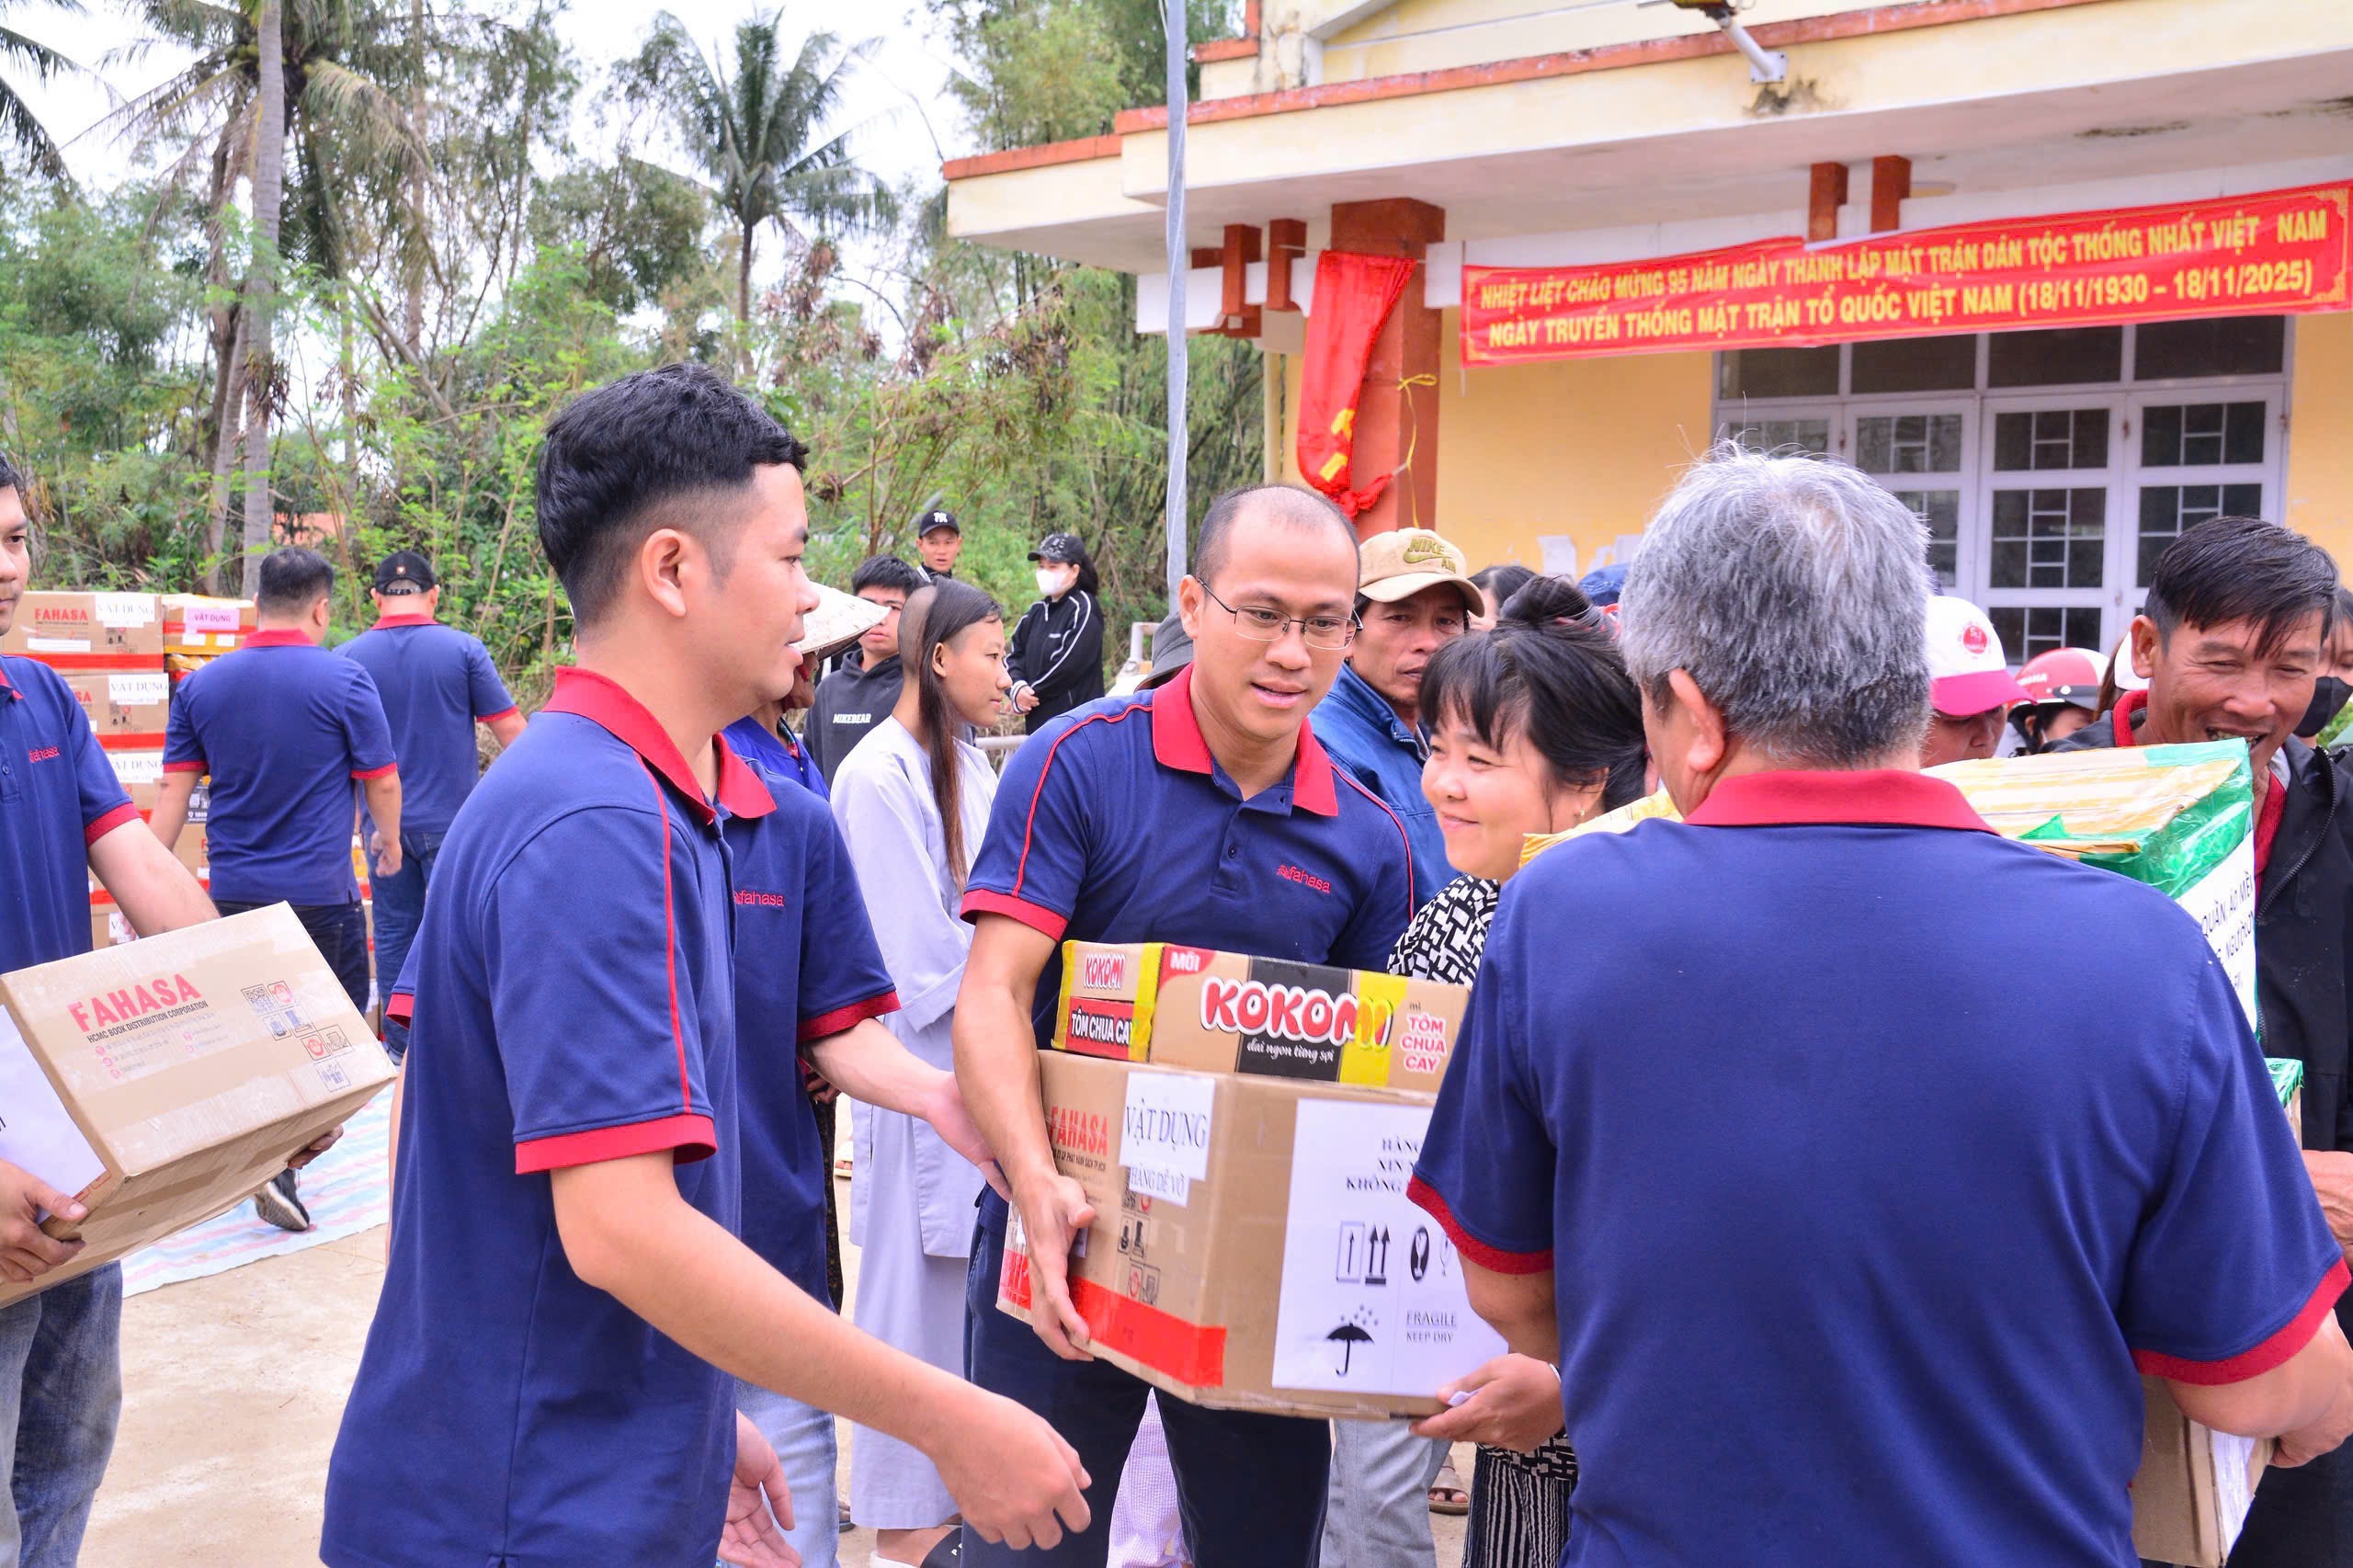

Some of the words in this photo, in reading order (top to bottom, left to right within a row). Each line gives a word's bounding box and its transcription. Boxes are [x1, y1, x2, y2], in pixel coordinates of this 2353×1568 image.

[1481, 278, 1528, 313] NHIỆT
[1529, 275, 1564, 312] LIỆT
[1566, 272, 1611, 302] CHÀO
[1614, 268, 1665, 299] MỪNG
[1668, 269, 1688, 294] 95
[1691, 261, 1729, 292] NĂM
[1733, 255, 1779, 289] NGÀY
[1785, 251, 1843, 285] THÀNH
[1847, 245, 1881, 286] LẬP
[1886, 244, 1924, 283] MẶT
[1929, 238, 1979, 279] TRẬN
[1983, 234, 2023, 269] DÂN
[2028, 230, 2067, 272] TỘC
[2072, 221, 2143, 262] THỐNG
[2147, 211, 2205, 256] NHẤT
[2211, 210, 2259, 256] VIỆT
[2278, 210, 2327, 243] NAM
[1490, 314, 1540, 347] NGÀY
[1625, 300, 1691, 337] THỐNG
[1698, 300, 1740, 338] MẶT
[1745, 294, 1800, 335] TRẬN
[1805, 284, 1835, 324] TỔ
[1839, 283, 1901, 324] QUỐC
[1906, 282, 1956, 324] VIỆT
[1963, 284, 2013, 315] NAM
[2018, 274, 2148, 316] (18/11/1930
[2174, 258, 2313, 300] 18/11/2025)
[1408, 538, 1445, 554] NIKE
[35, 608, 88, 621] FAHASA
[1290, 866, 1331, 894] fahasa
[741, 890, 785, 907] fahasa
[1084, 954, 1126, 990] KOKOMI
[67, 973, 201, 1032] FAHASA
[1201, 977, 1392, 1050] KOKOMI
[87, 1030, 109, 1043] HCMC
[108, 1024, 127, 1037] BOOK
[128, 1012, 169, 1031] DISTRIBUTION
[168, 1000, 209, 1018] CORPORATION
[1072, 1009, 1089, 1039] TÔM
[1089, 1017, 1115, 1042] CHUA
[1408, 1013, 1444, 1034] TÔM
[1247, 1038, 1265, 1052] dai
[1267, 1041, 1291, 1059] ngon
[1401, 1035, 1446, 1053] CHUA
[1405, 1055, 1438, 1072] CAY
[1050, 1106, 1108, 1156] FAHASA
[1126, 1097, 1156, 1146] VẬT
[1159, 1109, 1208, 1152] DỤNG
[1407, 1311, 1457, 1326] FRAGILE
[1406, 1331, 1431, 1343] KEEP
[1434, 1331, 1453, 1343] DRY
